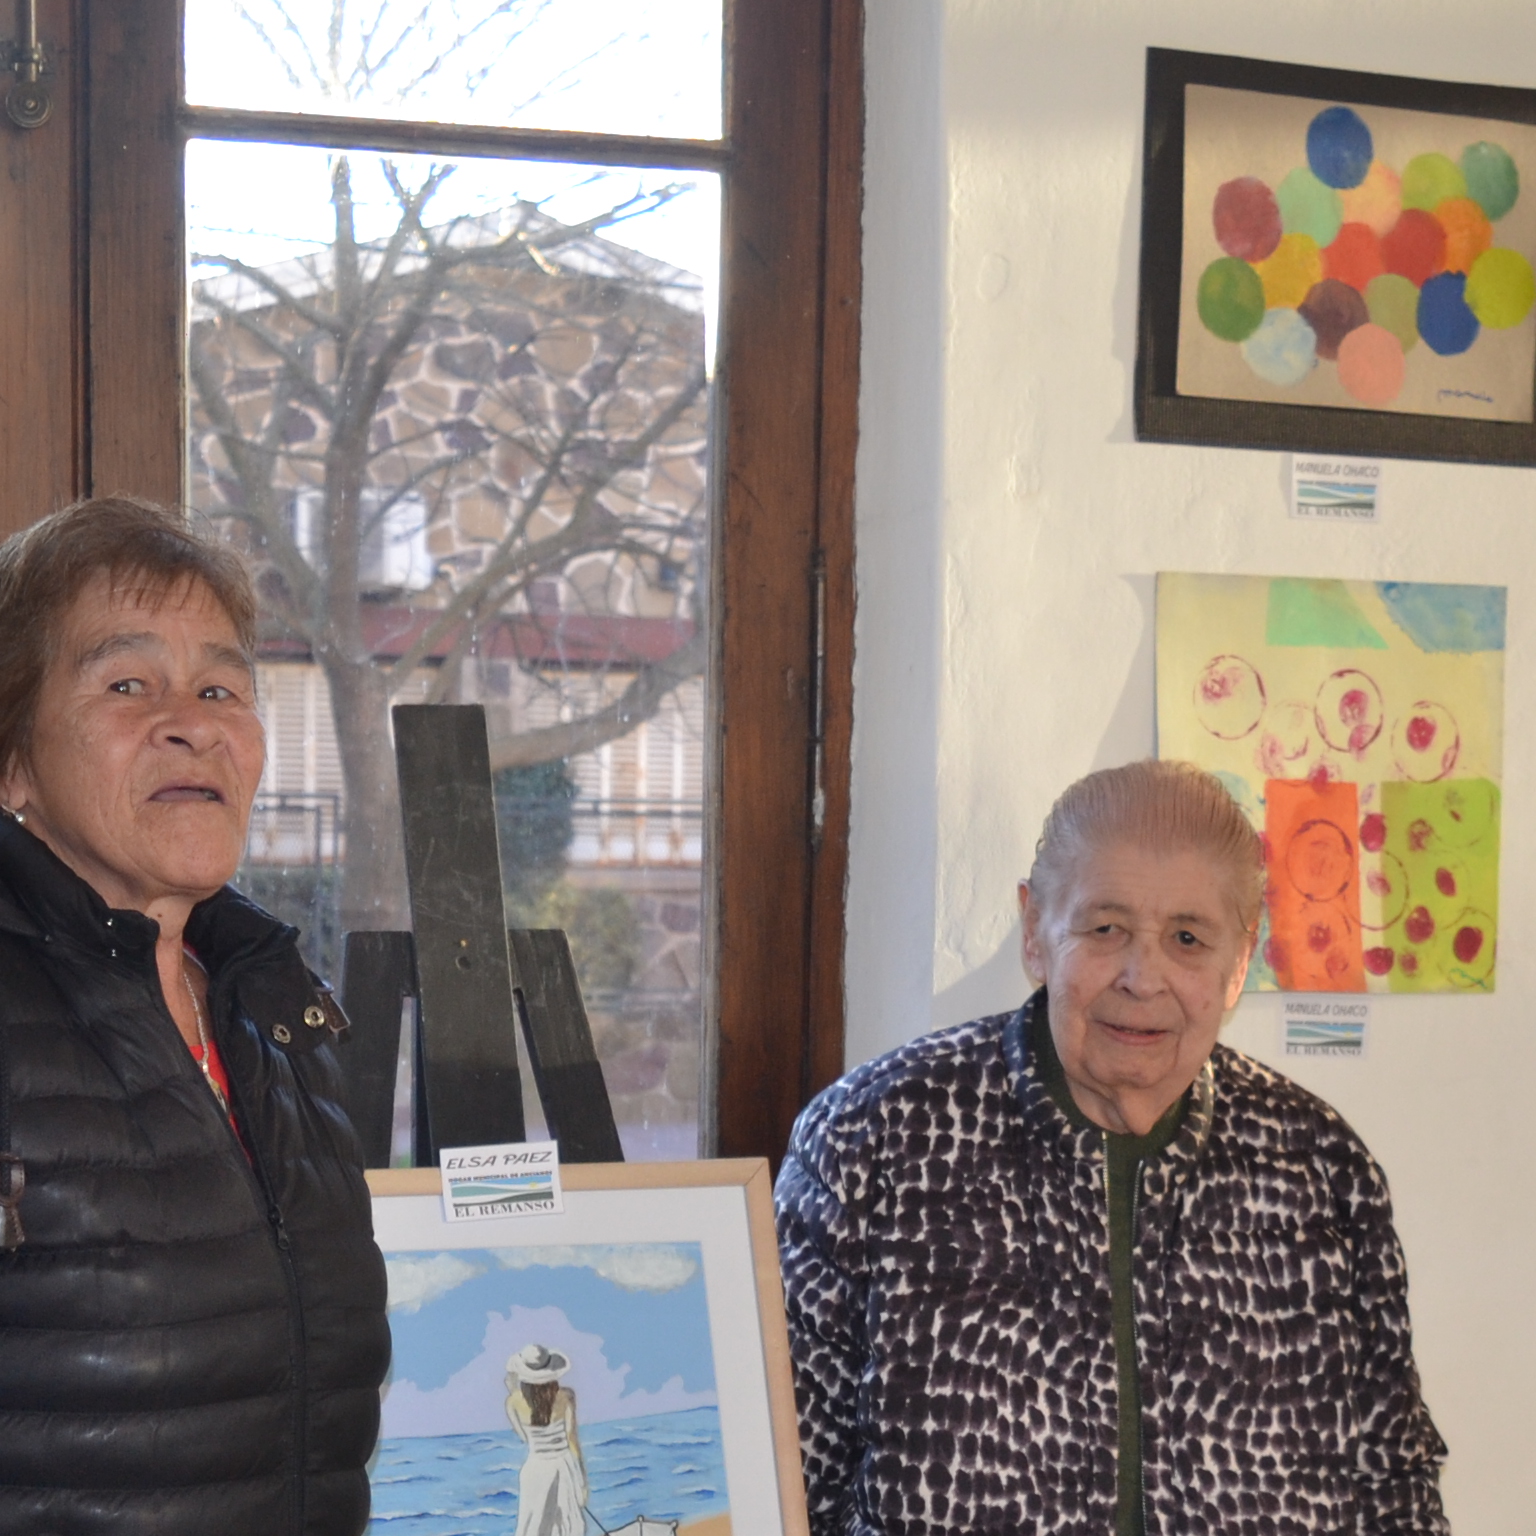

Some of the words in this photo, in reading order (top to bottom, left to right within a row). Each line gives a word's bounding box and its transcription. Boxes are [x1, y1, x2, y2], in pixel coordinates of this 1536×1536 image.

[1295, 462, 1341, 475] MANUELA
[1285, 1003, 1330, 1016] MANUELA
[1332, 1004, 1368, 1017] OHACO
[446, 1155, 497, 1170] ELSA
[503, 1151, 552, 1166] PAEZ
[454, 1206, 475, 1218] EL
[479, 1200, 555, 1216] REMANSO
